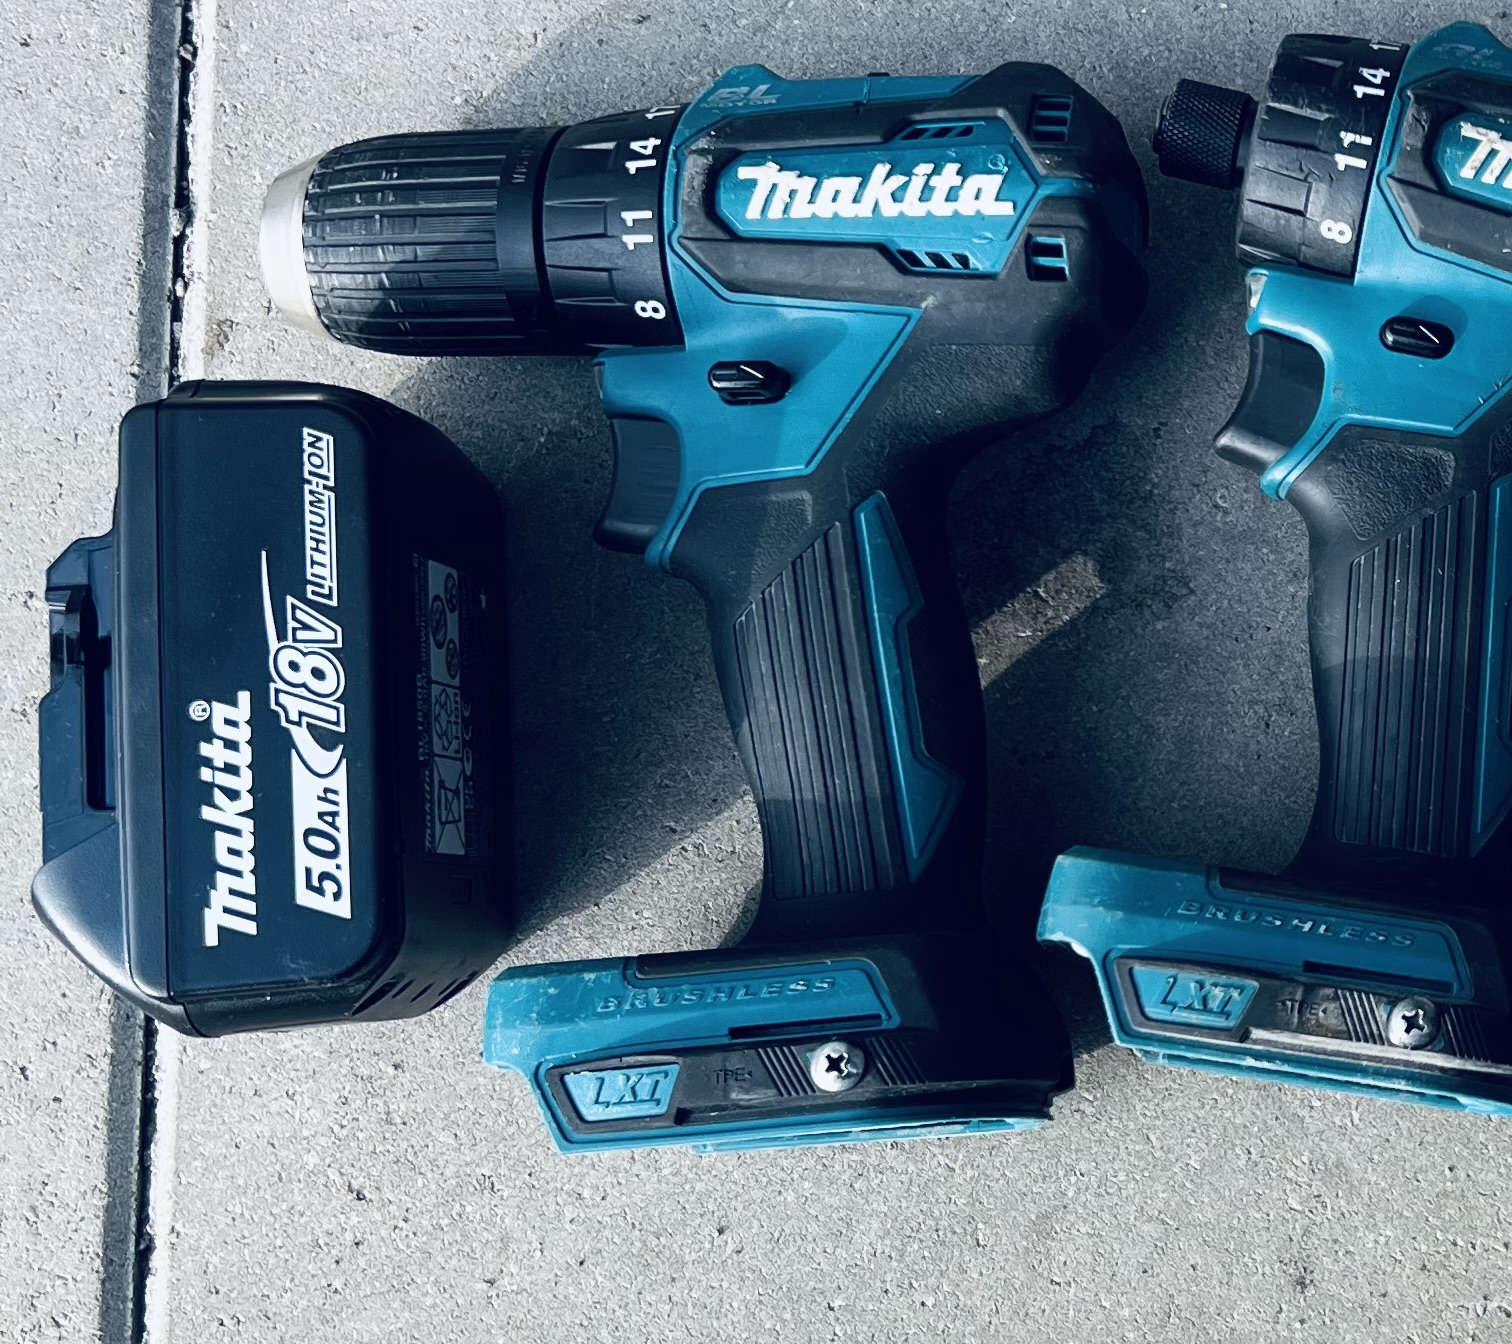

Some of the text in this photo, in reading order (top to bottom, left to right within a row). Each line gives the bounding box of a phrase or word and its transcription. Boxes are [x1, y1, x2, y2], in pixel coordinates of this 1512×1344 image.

[1353, 67, 1391, 99] 14
[624, 137, 662, 175] 14
[1333, 130, 1373, 171] 11
[620, 210, 654, 250] 11
[1320, 218, 1353, 244] 8
[634, 299, 667, 320] 8
[306, 430, 335, 602] LITHIUM-ION
[269, 596, 345, 733] 18V
[303, 787, 342, 904] 5.0Ah
[1176, 898, 1416, 948] BRUSHLESS
[596, 977, 837, 1013] BRUSHLESS
[1160, 974, 1244, 1023] LXT
[593, 1067, 670, 1109] LXT
